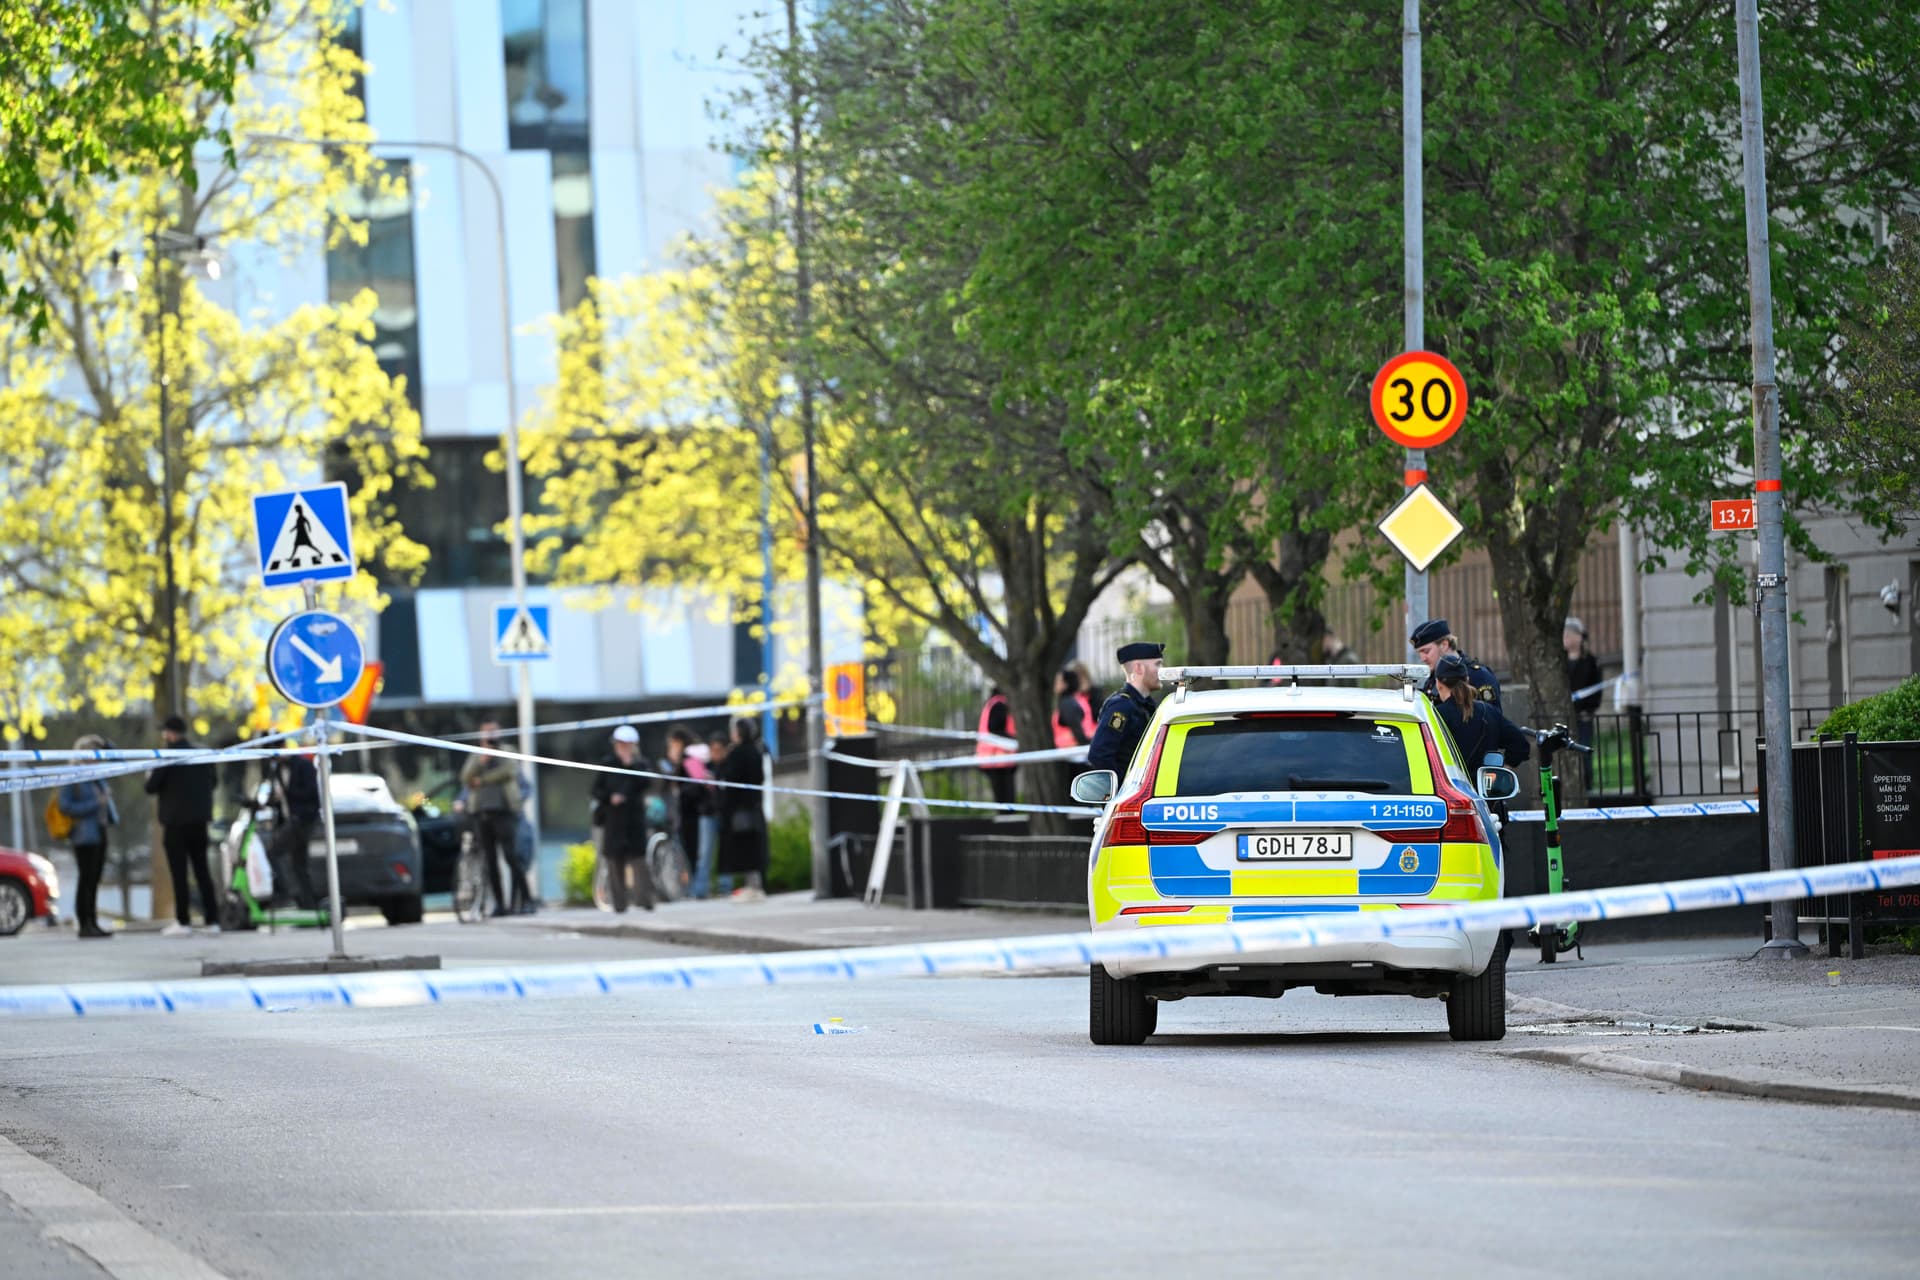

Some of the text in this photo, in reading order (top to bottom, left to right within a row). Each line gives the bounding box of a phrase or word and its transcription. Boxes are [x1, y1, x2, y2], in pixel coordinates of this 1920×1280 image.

[1390, 378, 1452, 421] 30
[1719, 508, 1751, 526] 13,7
[1873, 774, 1911, 783] ÖPPETTIDER
[1163, 805, 1218, 821] POLIS
[1370, 804, 1433, 817] 1 21-1150
[1876, 803, 1910, 812] SÖNDAGAR
[1256, 836, 1342, 856] GDH 78J
